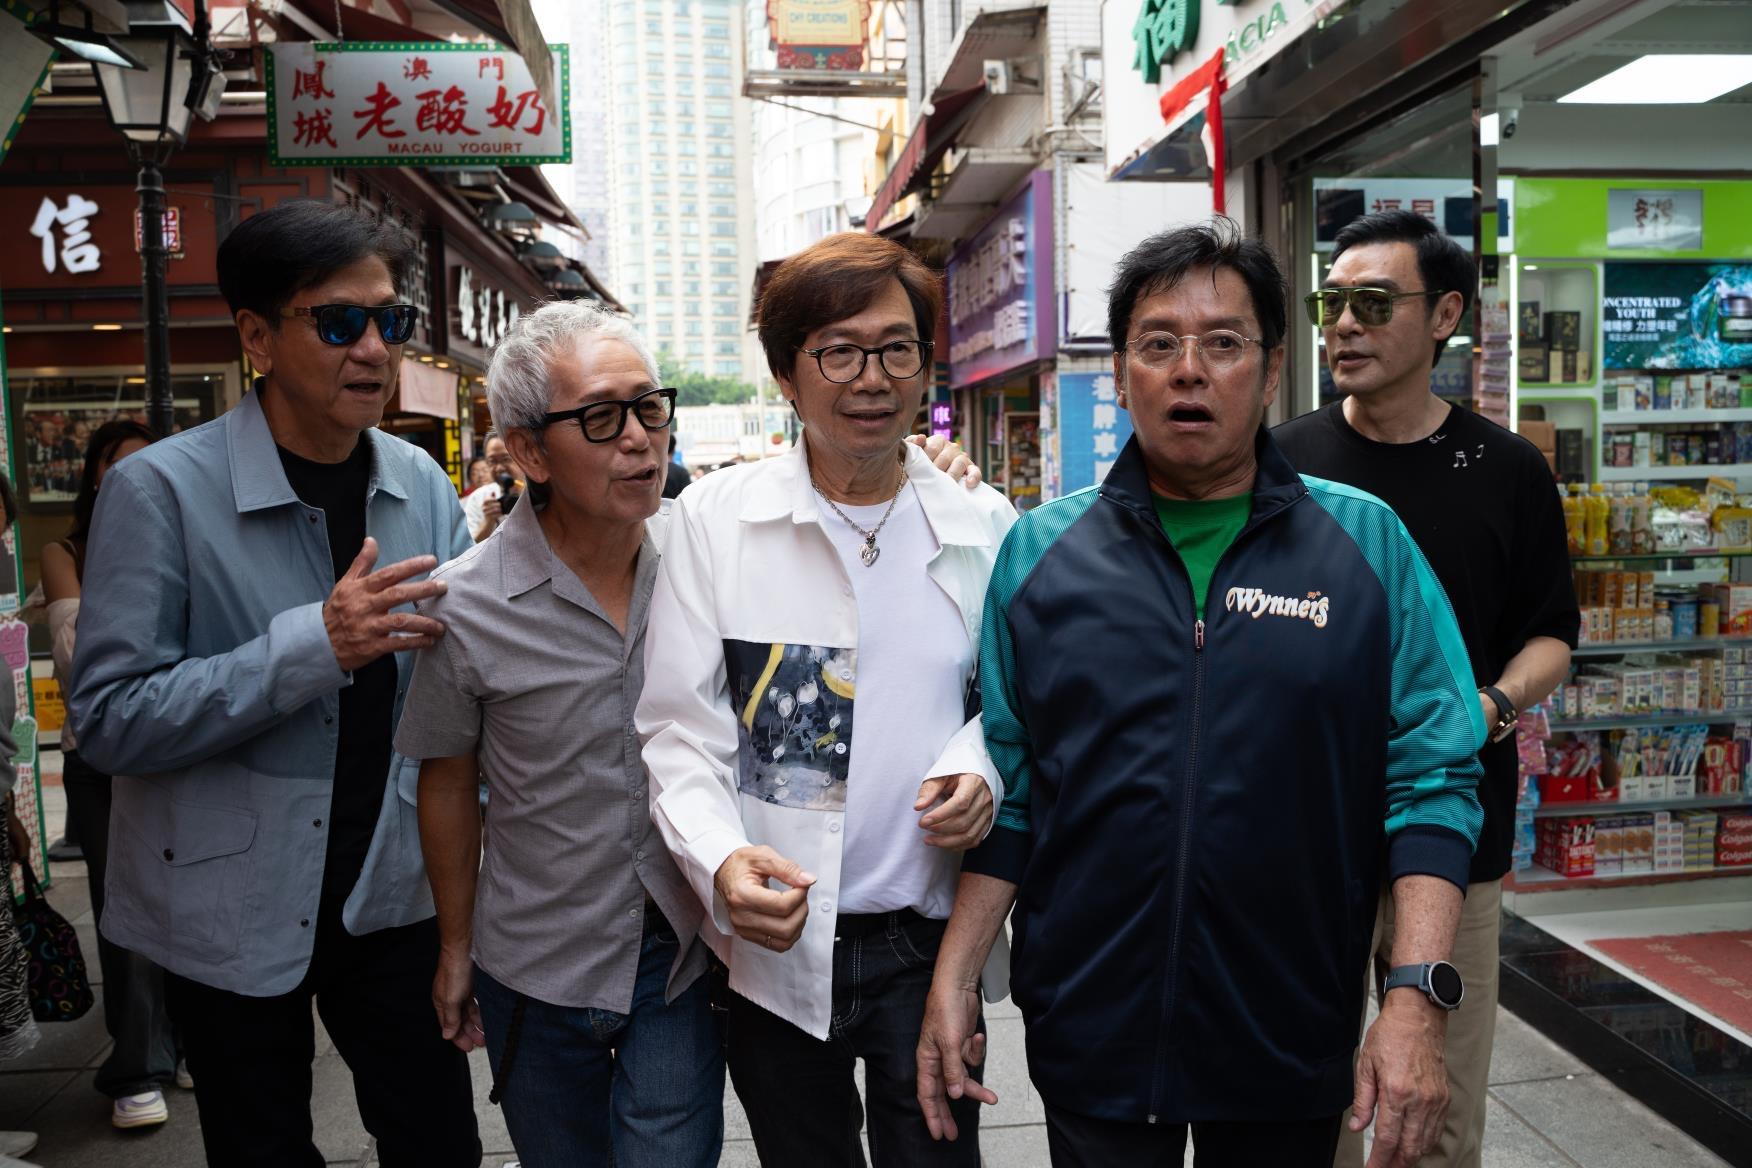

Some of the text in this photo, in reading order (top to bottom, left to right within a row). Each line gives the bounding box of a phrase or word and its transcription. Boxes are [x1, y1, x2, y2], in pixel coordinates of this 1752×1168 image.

[403, 56, 505, 81] 澳門
[292, 60, 338, 148] 鳳城
[353, 81, 546, 140] 老酸奶
[388, 143, 523, 154] MACAU YOGURT
[30, 193, 101, 274] 信
[1616, 308, 1656, 319] YOUTH
